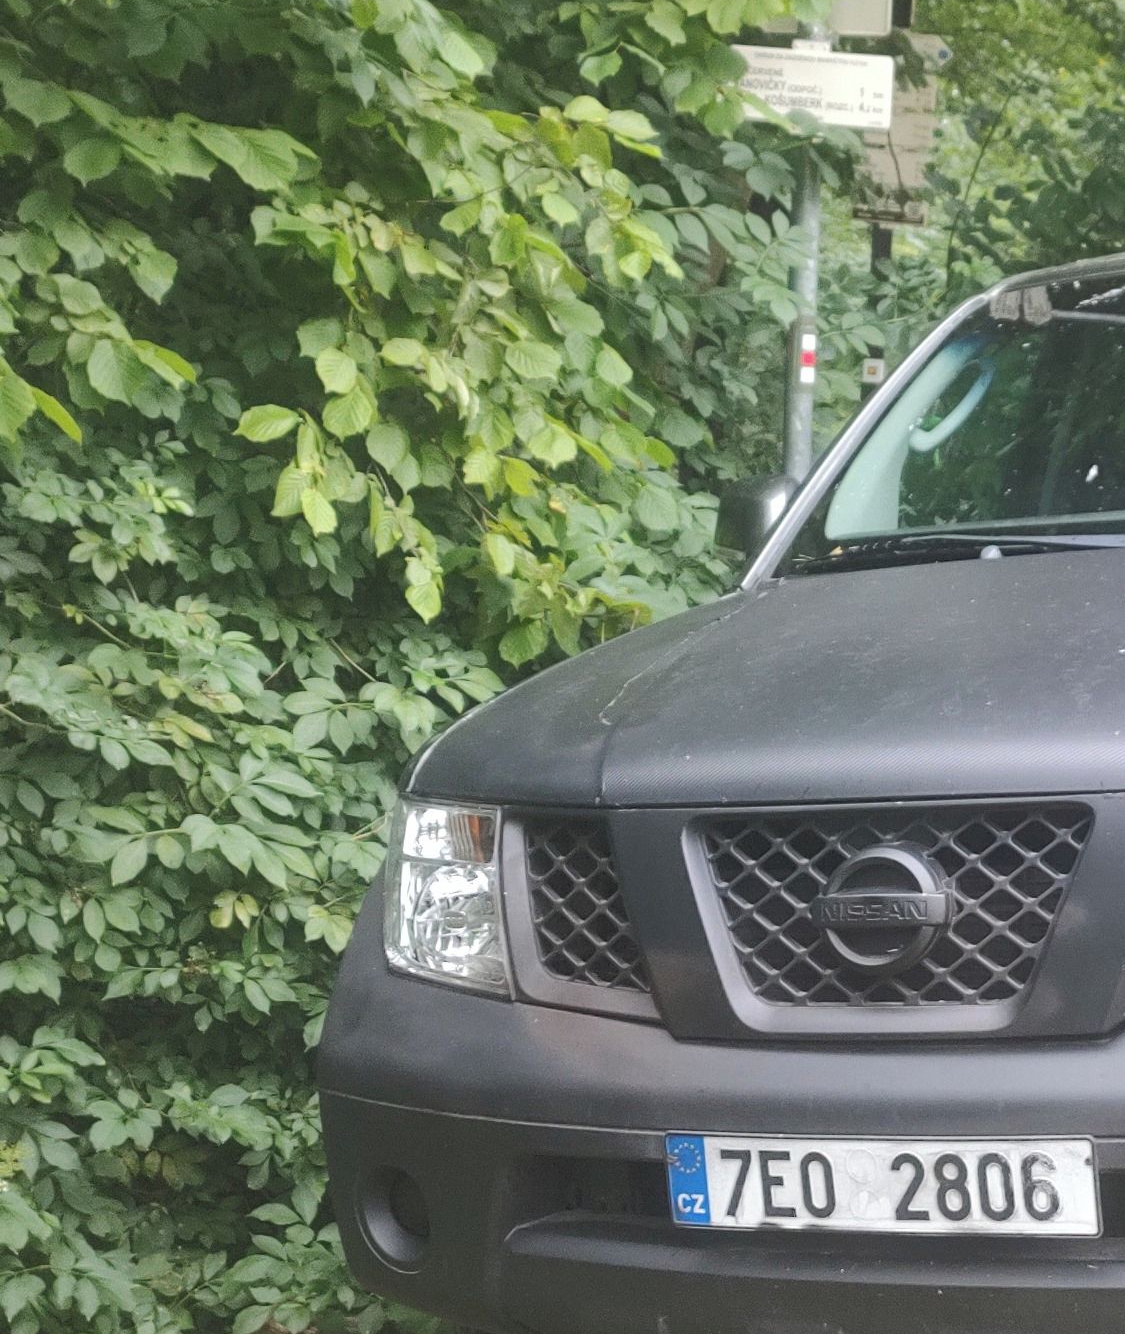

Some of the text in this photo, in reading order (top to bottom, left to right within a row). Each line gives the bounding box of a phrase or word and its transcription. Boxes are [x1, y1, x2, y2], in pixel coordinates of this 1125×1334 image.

[820, 900, 928, 922] NISSAN
[676, 1149, 1063, 1222] CZ 7E0 2806
